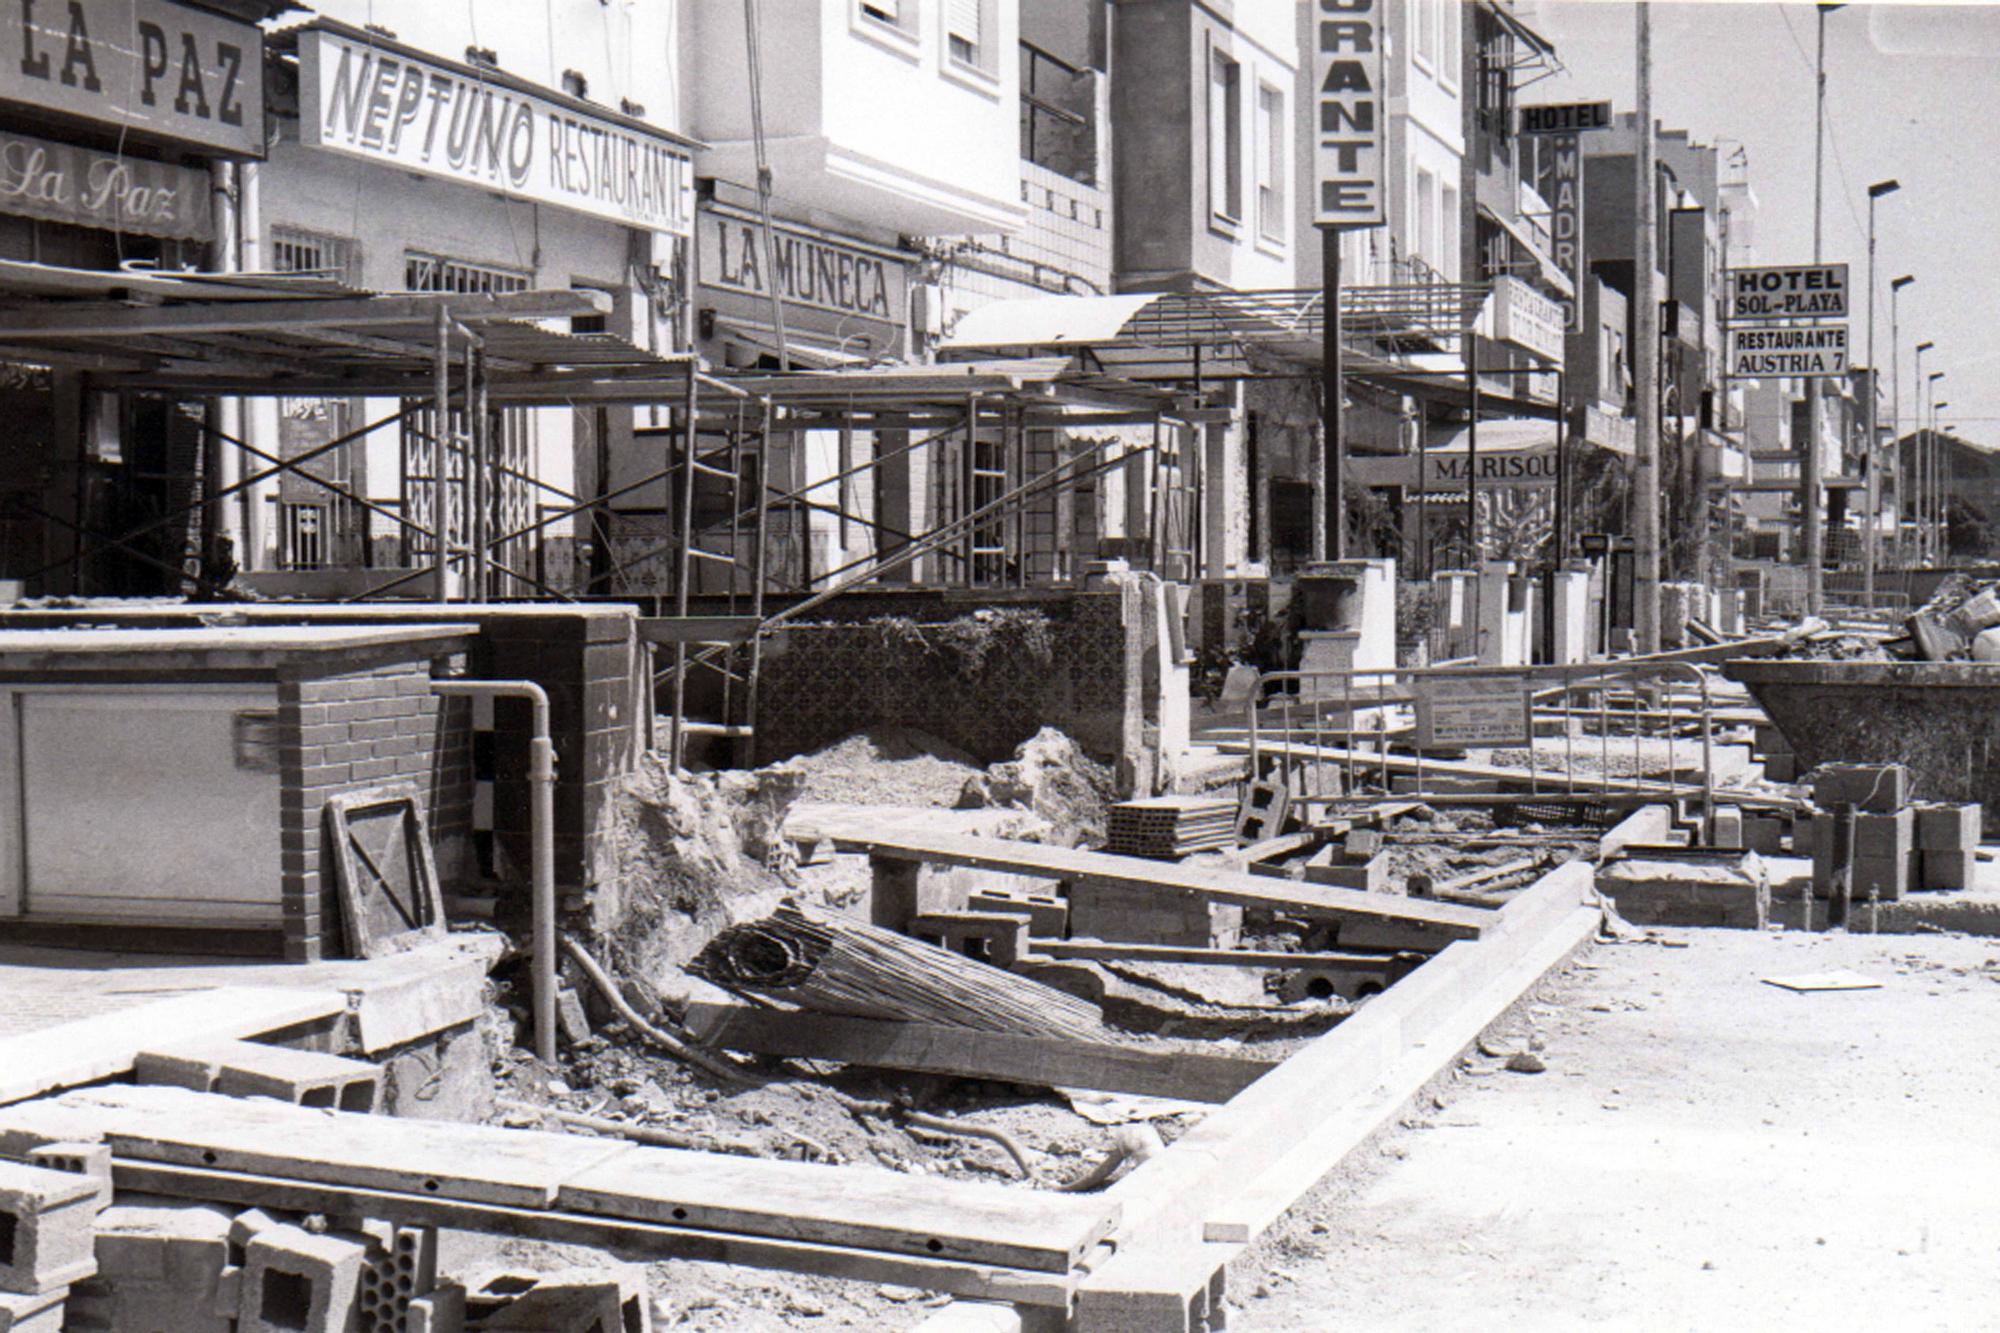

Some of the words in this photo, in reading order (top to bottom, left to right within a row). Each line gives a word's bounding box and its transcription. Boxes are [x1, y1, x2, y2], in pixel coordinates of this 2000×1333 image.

[20, 0, 101, 93] LA
[138, 20, 243, 127] PAZ
[324, 46, 535, 188] NEPTUNO
[549, 113, 690, 223] RESTAURANTE
[1526, 103, 1609, 130] HOTEL
[0, 140, 69, 204] La
[80, 159, 177, 222] Paz
[718, 221, 763, 291] LA
[1556, 151, 1576, 326] MADRD
[1736, 292, 1843, 315] SOL-PLAYA
[1739, 270, 1842, 293] HOTEL
[1737, 329, 1845, 350] RESTAURANTE
[1737, 352, 1825, 373] AUSTRIA
[1833, 352, 1844, 371] 7
